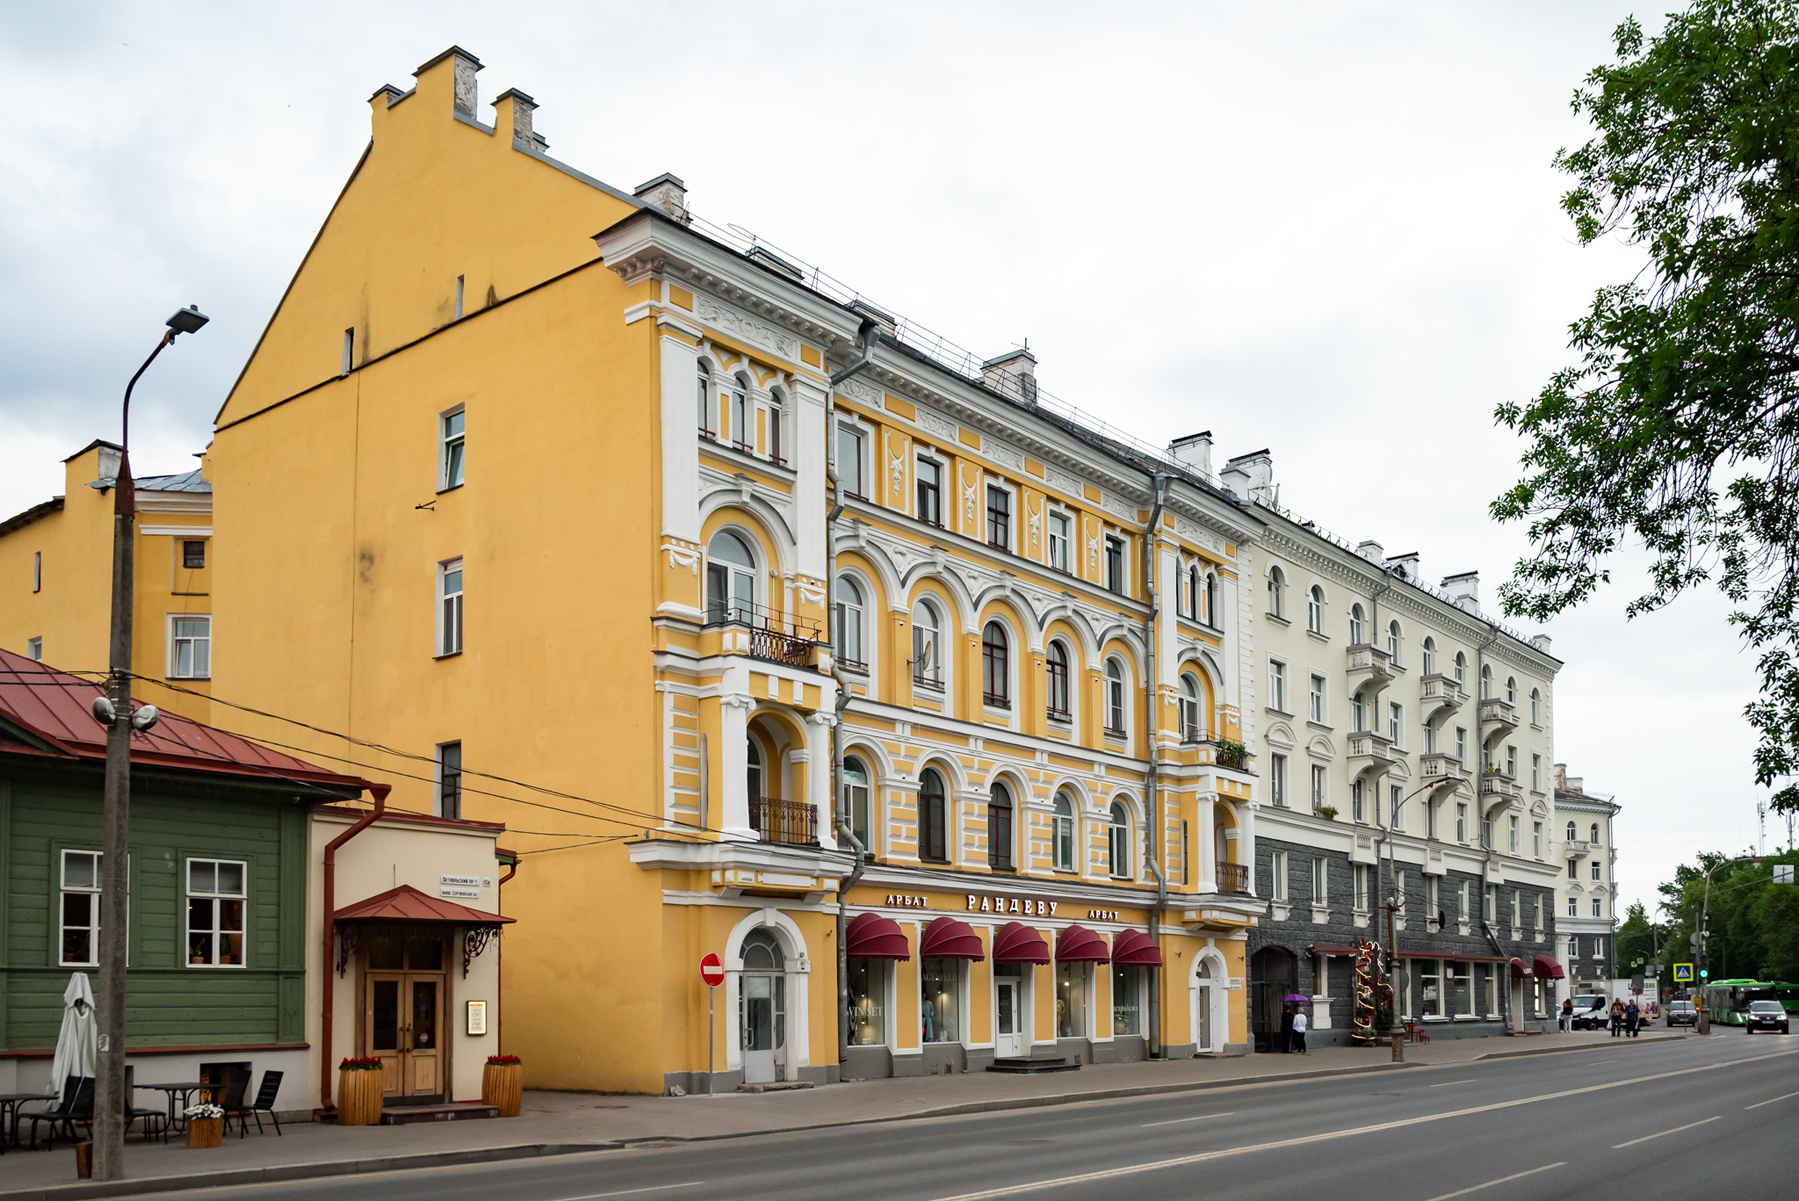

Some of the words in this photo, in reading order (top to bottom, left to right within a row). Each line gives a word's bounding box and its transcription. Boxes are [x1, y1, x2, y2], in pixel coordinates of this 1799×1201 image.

[886, 894, 928, 907] АРБАТ
[966, 894, 1058, 915] РАНДЕВУ
[1088, 909, 1119, 920] АРБАТ
